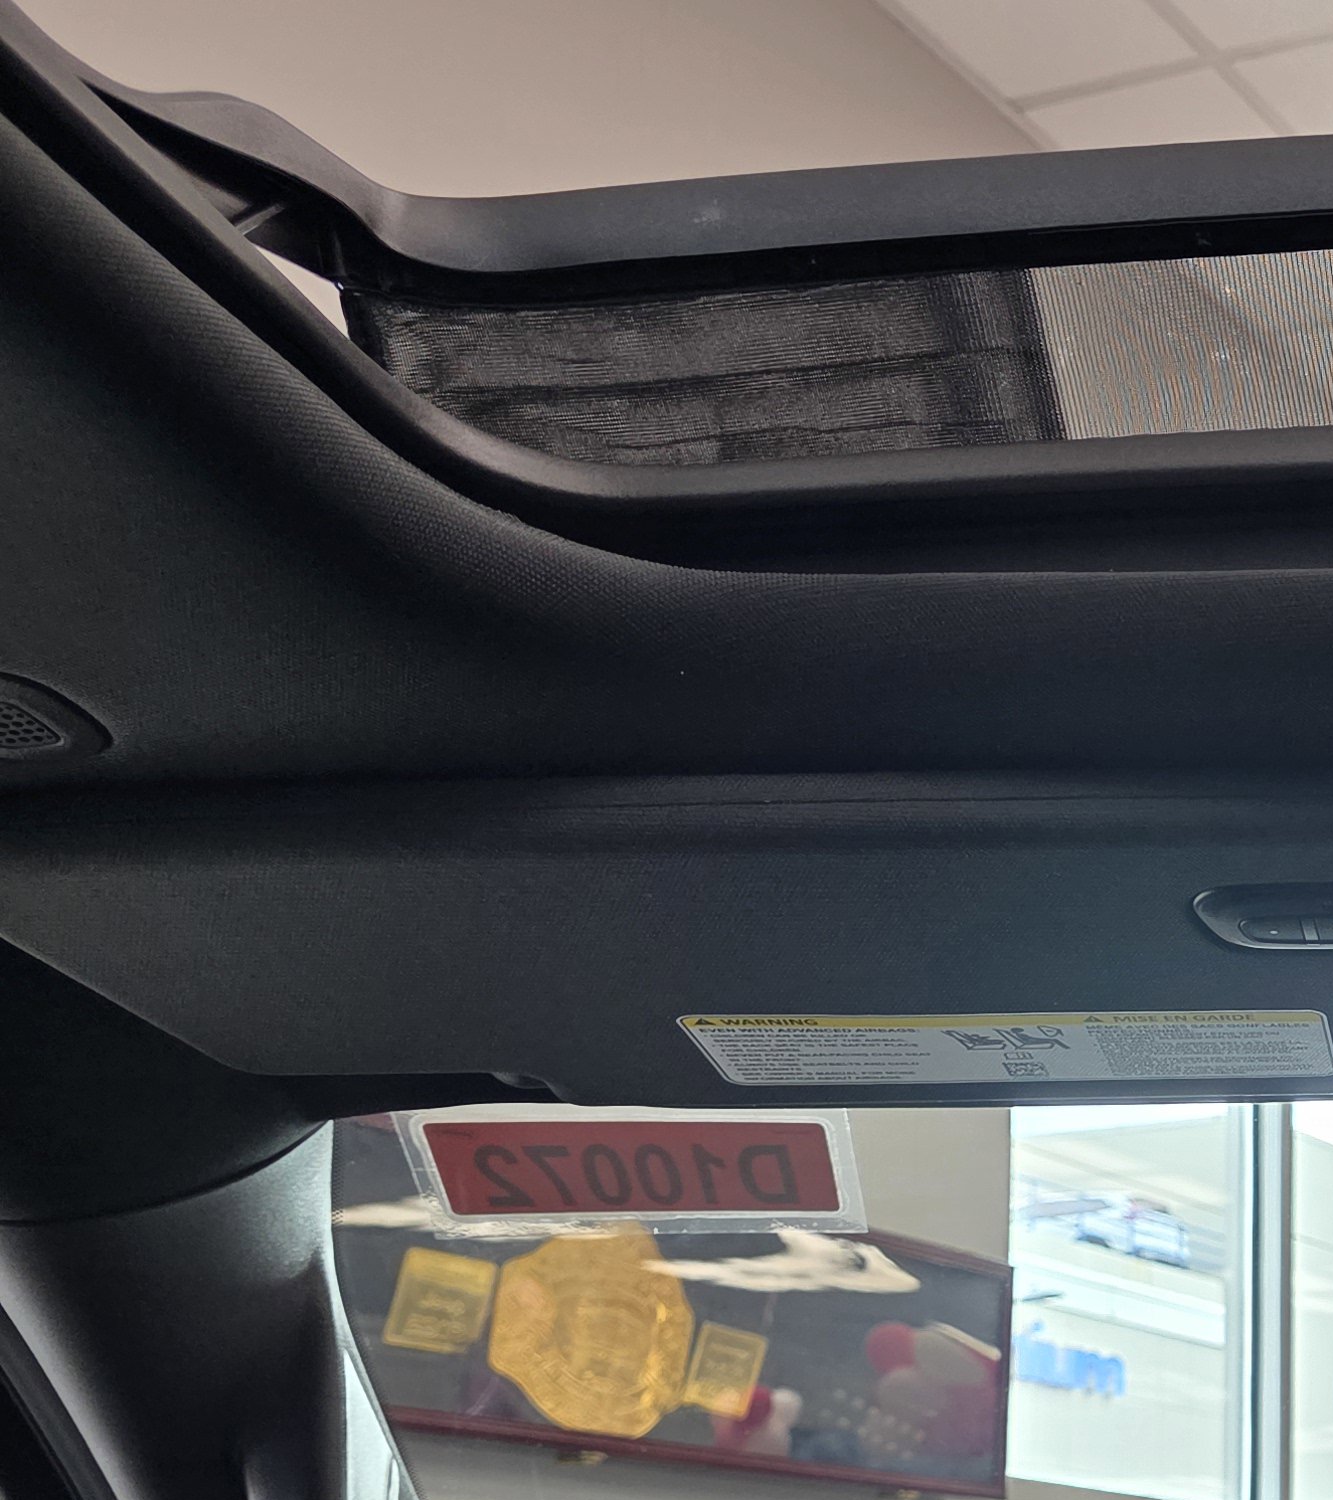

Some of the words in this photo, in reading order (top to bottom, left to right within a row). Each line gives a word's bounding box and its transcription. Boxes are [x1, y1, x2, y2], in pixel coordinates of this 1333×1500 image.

[719, 1018, 819, 1026] WARNING
[1112, 1015, 1158, 1023] MISE
[1193, 1014, 1255, 1022] GARDE
